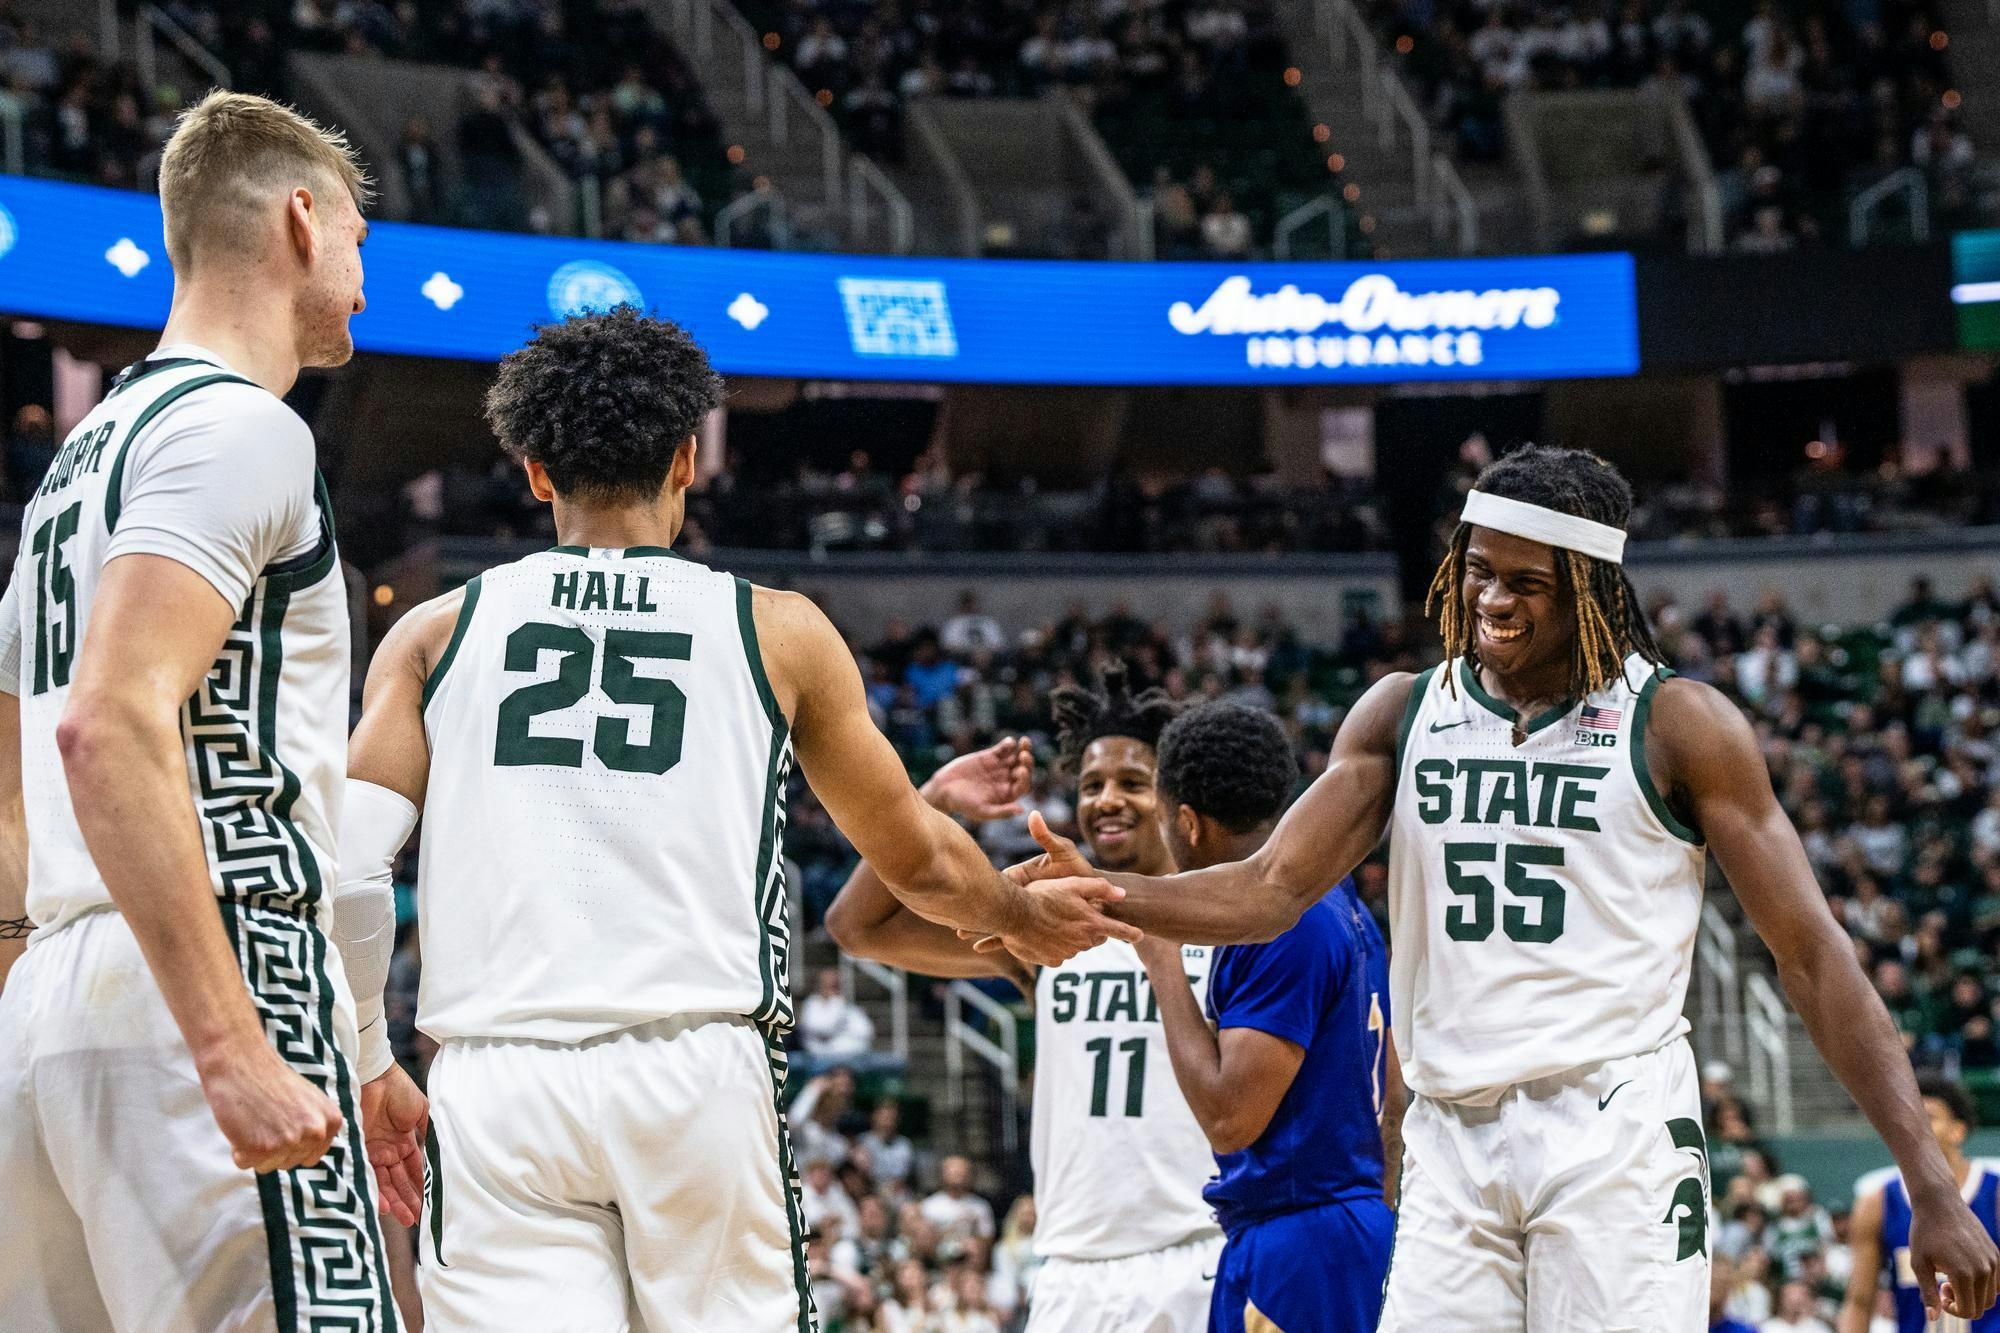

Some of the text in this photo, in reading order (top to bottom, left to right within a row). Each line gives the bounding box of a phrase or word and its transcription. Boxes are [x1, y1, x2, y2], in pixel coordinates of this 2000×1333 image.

[1168, 274, 1560, 335] Auto-Owners
[1246, 331, 1483, 369] INSURANCE
[32, 500, 83, 697] 15
[551, 571, 657, 612] HALL
[494, 622, 693, 775] 25
[1415, 758, 1611, 833] STATE
[1444, 842, 1566, 944] 55
[1086, 1037, 1147, 1118] 11
